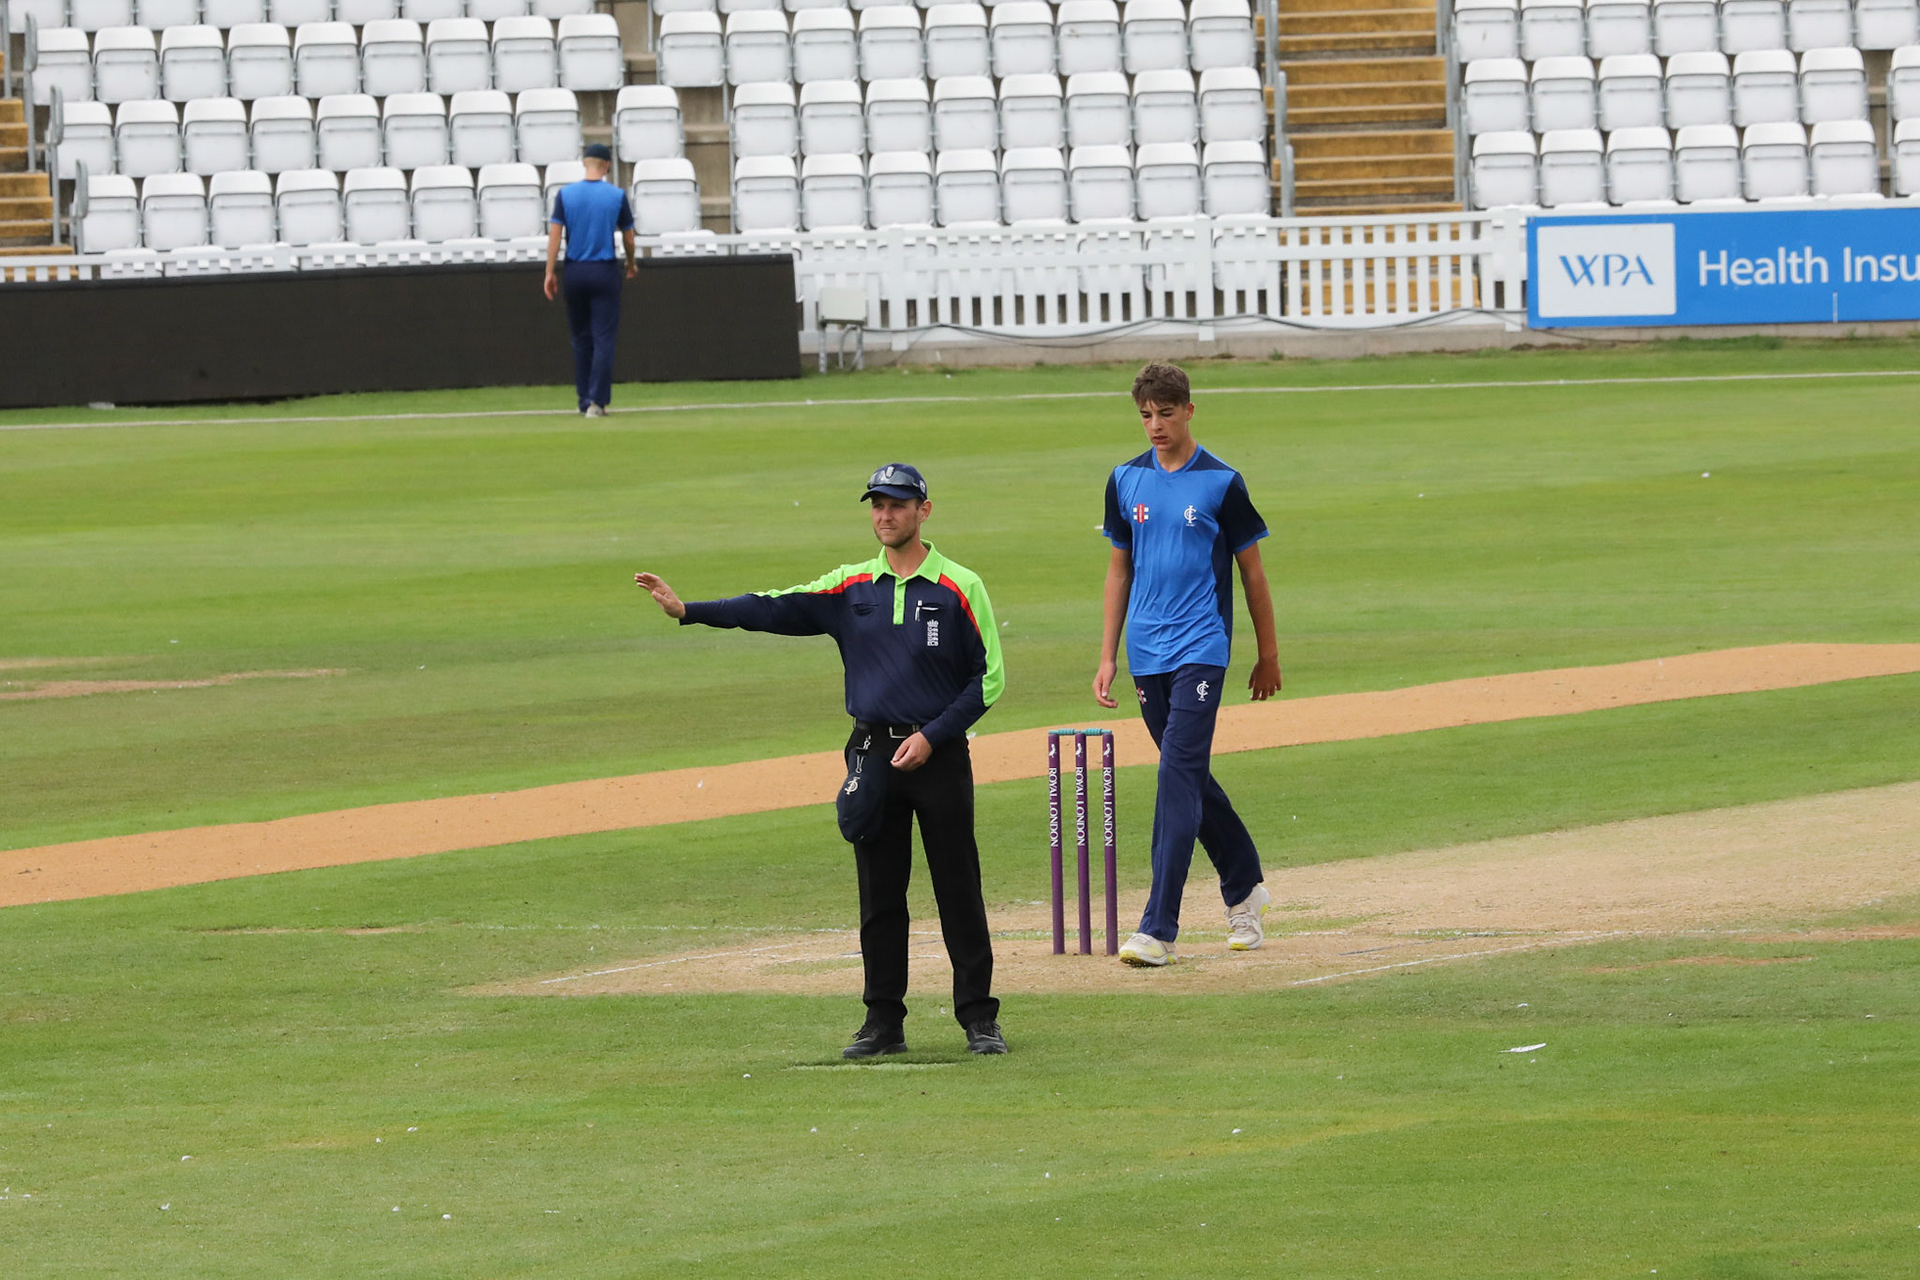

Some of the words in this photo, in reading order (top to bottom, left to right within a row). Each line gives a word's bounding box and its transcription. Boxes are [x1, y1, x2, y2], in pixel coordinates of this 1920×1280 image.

[1558, 254, 1655, 286] WPA
[1699, 246, 1829, 286] Health
[1843, 246, 1920, 283] Insu
[1049, 767, 1058, 800] ROYAL
[1075, 767, 1084, 799] ROYAL
[1103, 767, 1112, 799] ROYAL
[1049, 801, 1059, 847] LONDON
[1076, 800, 1086, 846] LONDON
[1103, 801, 1113, 847] LONDON
